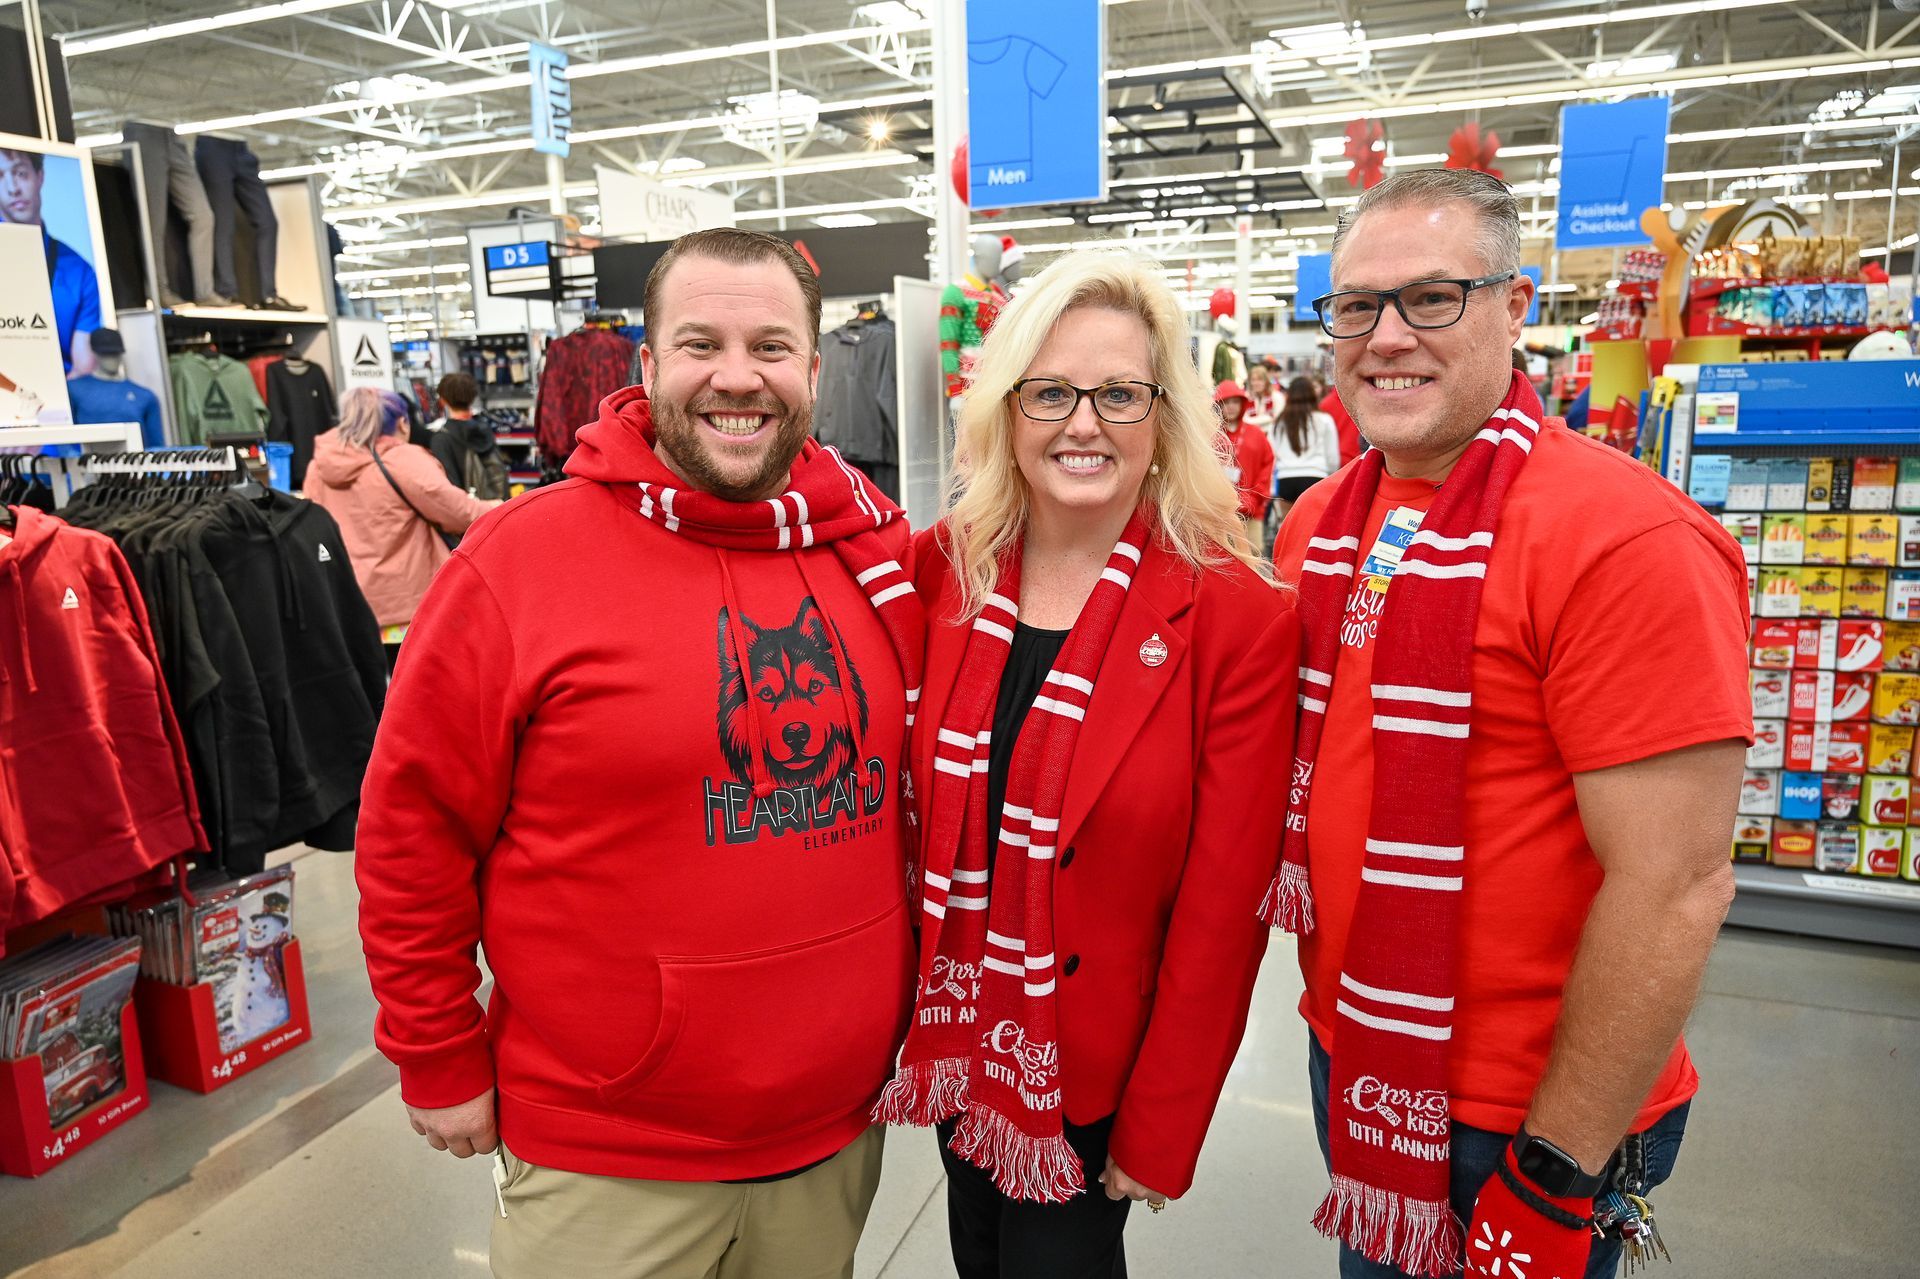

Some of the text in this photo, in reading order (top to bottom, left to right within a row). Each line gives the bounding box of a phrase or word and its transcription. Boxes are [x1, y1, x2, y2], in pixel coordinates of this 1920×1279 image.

[987, 167, 1026, 186] Men
[646, 191, 698, 230] CHAPS
[1570, 202, 1629, 219] Assisted
[1569, 219, 1636, 234] Checkout
[703, 756, 886, 847] HEARTLAND
[804, 818, 884, 850] ELEMENTARY
[919, 1006, 951, 1026] 10TH
[983, 1060, 1016, 1089] 10TH
[1346, 1118, 1384, 1148] 10TH
